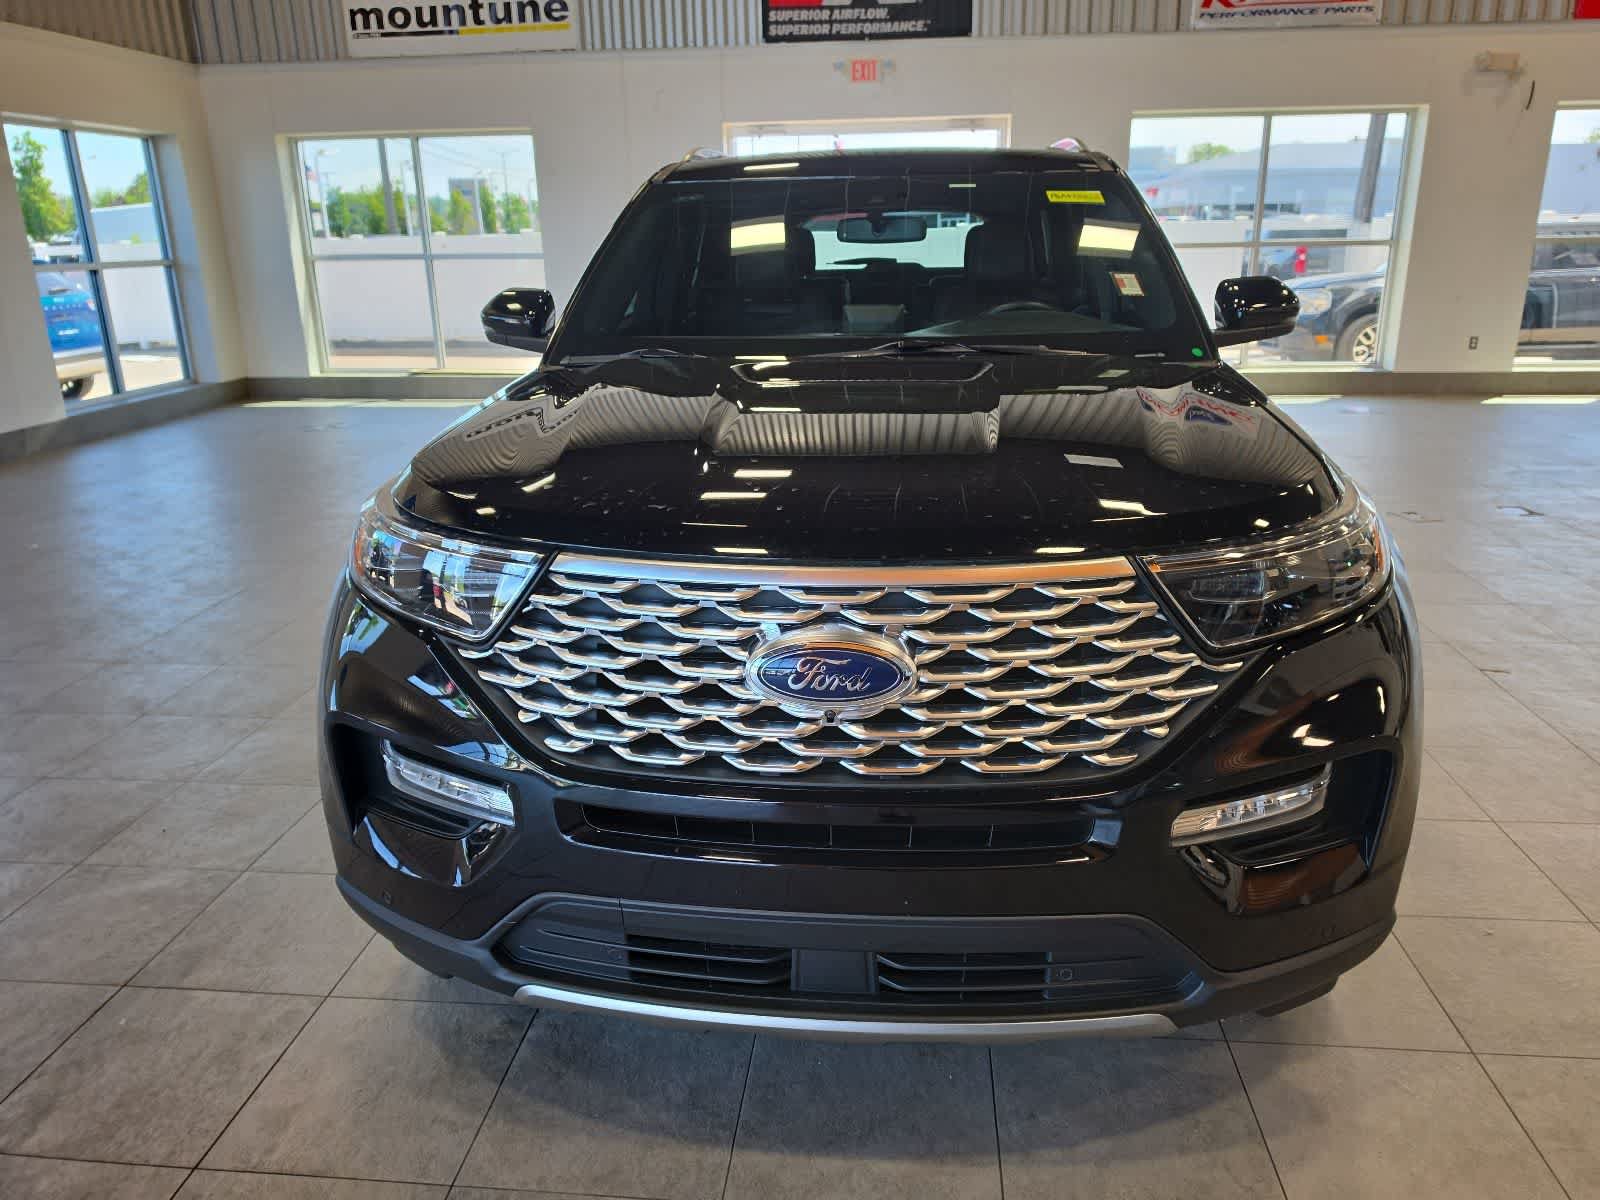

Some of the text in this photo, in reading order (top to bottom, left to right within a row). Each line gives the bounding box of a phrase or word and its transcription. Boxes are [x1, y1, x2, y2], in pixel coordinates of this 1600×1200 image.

[349, 0, 569, 31] mountune
[768, 7, 890, 22] SUPERIOR AIRFLOW.
[1199, 5, 1375, 19] PERFORMANCE PARTS
[768, 23, 830, 36] SUPERIOR
[851, 60, 877, 82] EXIT
[787, 656, 873, 692] Ford
